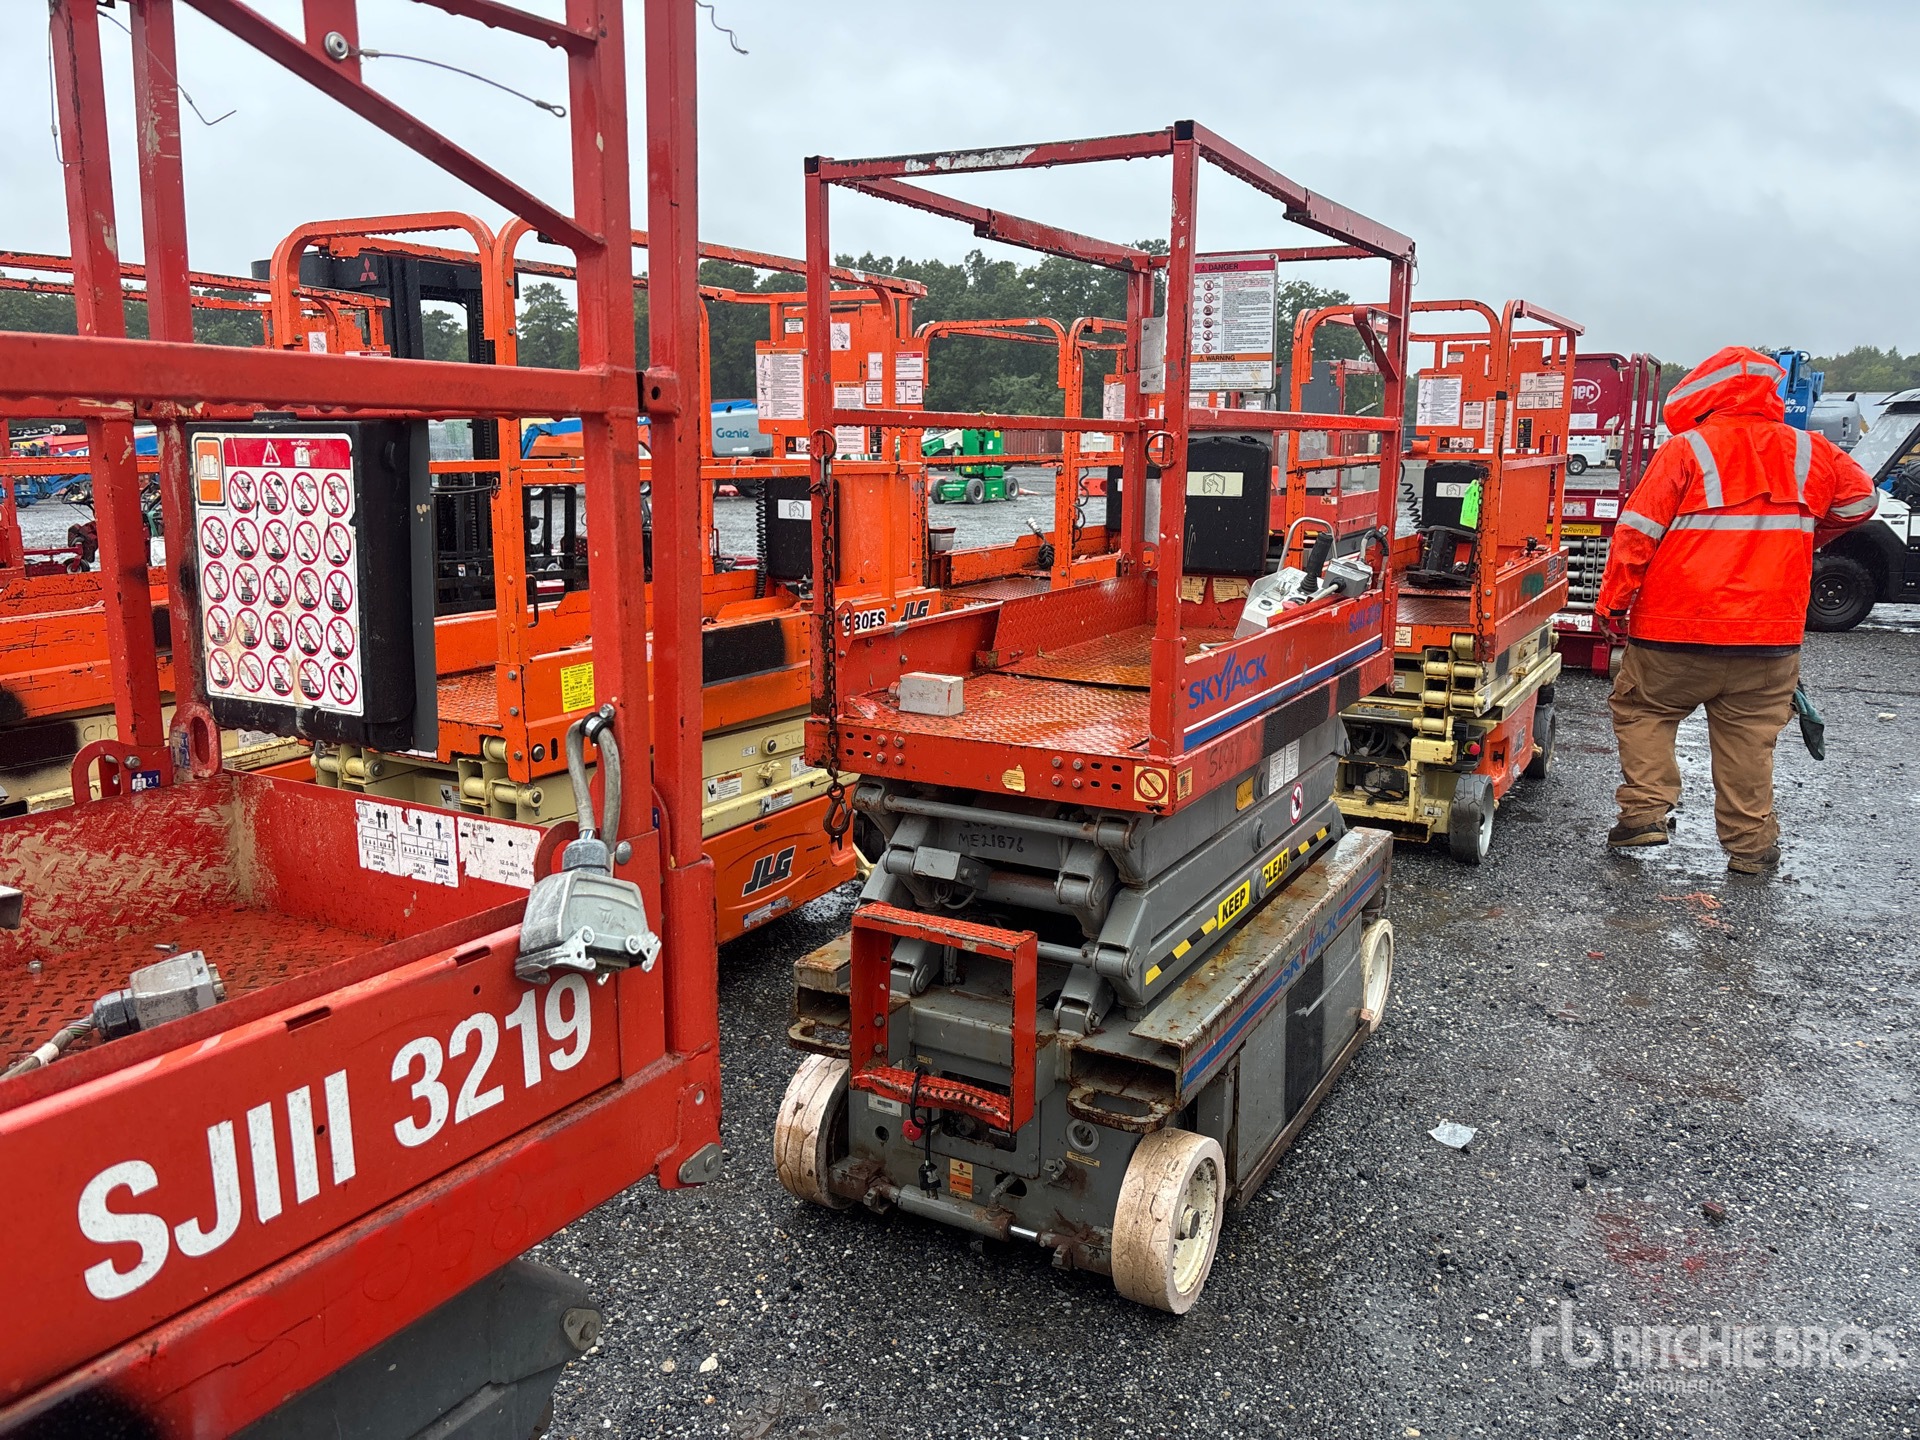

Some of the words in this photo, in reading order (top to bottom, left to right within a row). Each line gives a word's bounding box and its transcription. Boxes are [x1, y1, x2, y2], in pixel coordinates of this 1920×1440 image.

[716, 428, 749, 438] Genie
[900, 600, 930, 622] JLG
[1188, 651, 1267, 709] SKYJACK
[155, 775, 159, 784] 1
[742, 845, 796, 898] JLG
[1222, 888, 1246, 922] KEEP
[1264, 852, 1288, 884] CLEAR
[77, 1068, 357, 1300] SJIII
[391, 972, 592, 1147] 3219
